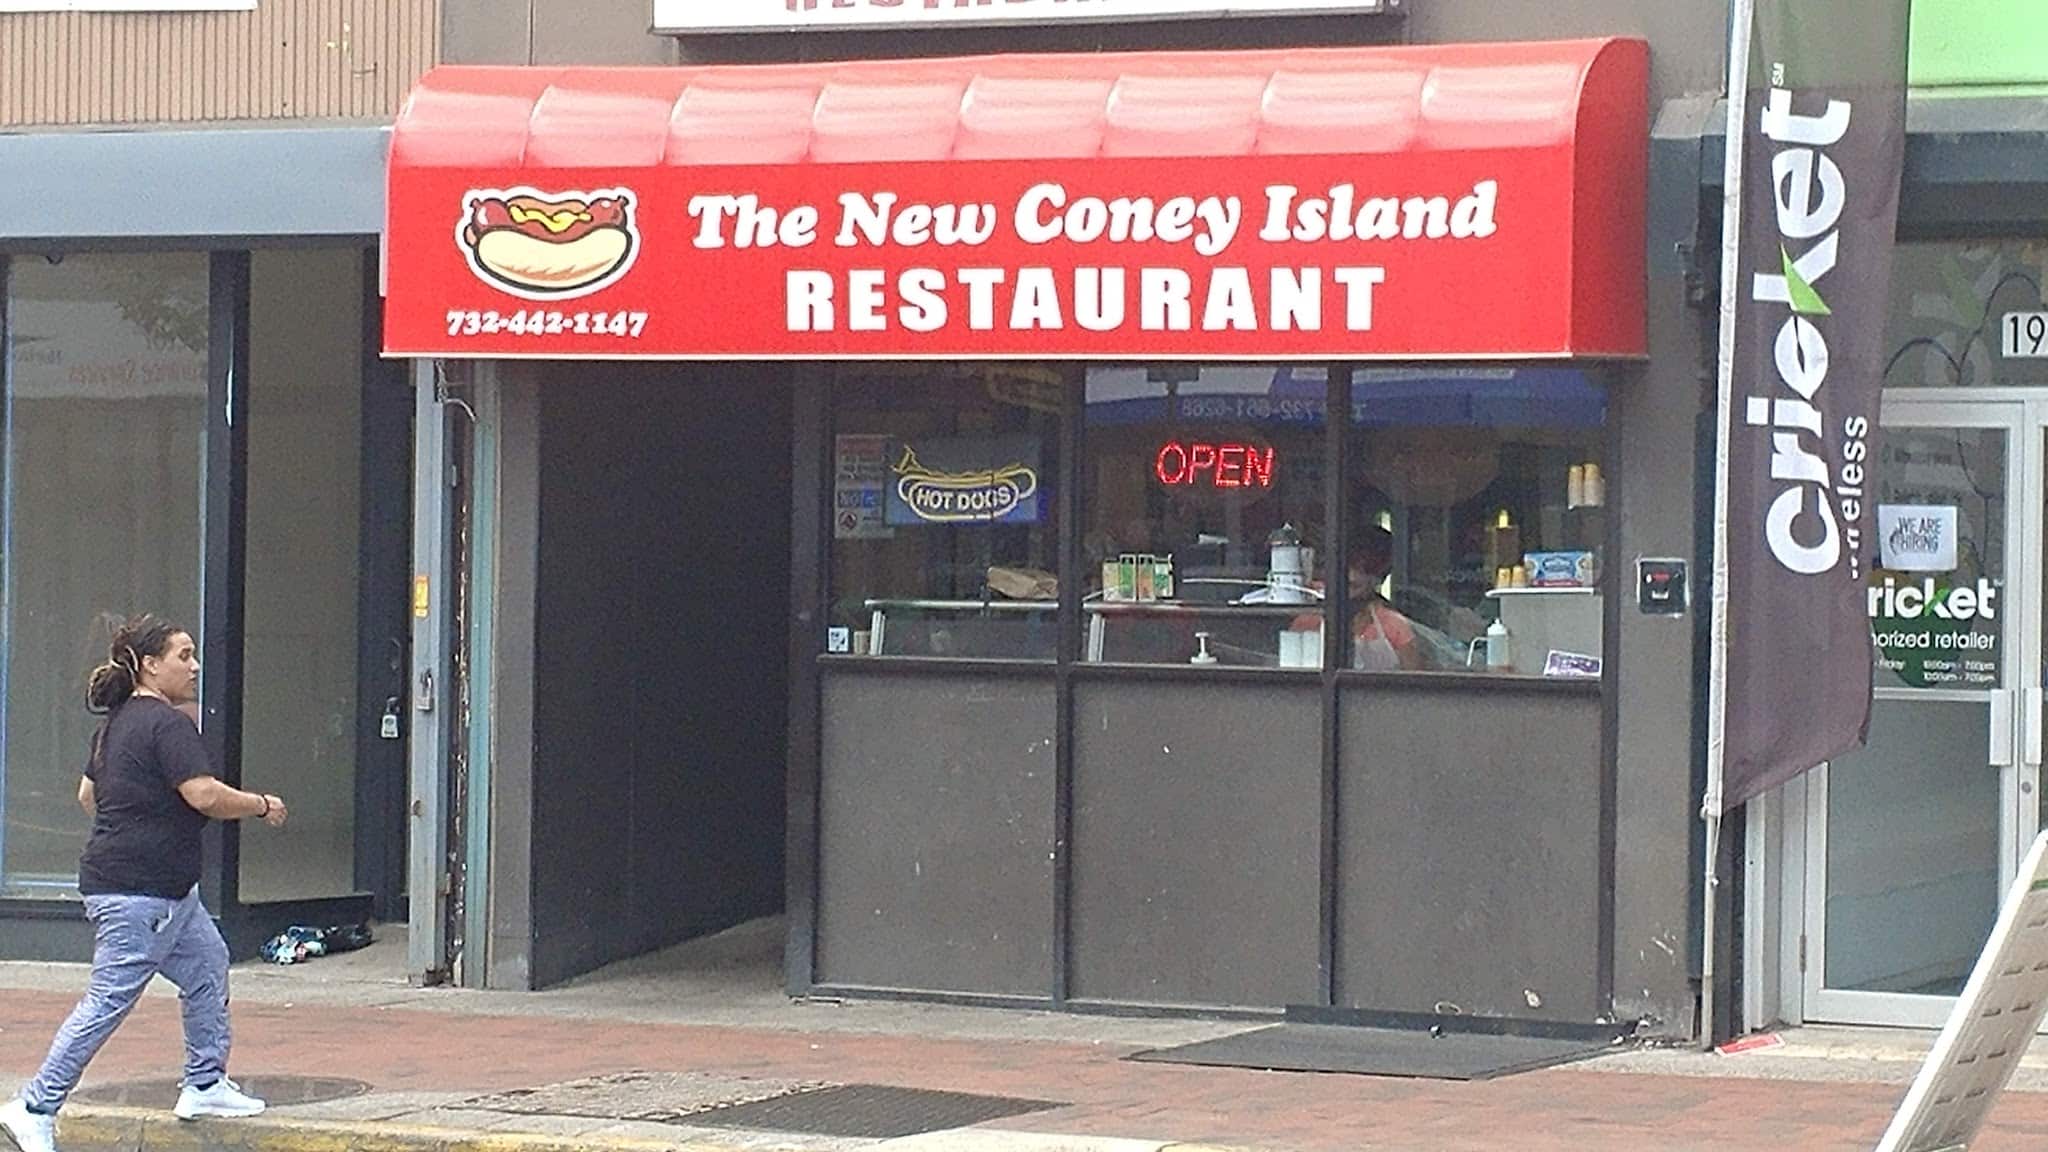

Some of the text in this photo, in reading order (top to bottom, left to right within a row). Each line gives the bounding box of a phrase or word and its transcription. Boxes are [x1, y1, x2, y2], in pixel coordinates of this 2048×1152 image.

[687, 179, 1499, 257] The New Coney Island
[786, 266, 1386, 332] RESTAURANT
[446, 309, 649, 338] 732-442-1147
[1747, 88, 1851, 574] cricket
[2010, 315, 2045, 354] 19
[1156, 440, 1275, 488] OPEN
[916, 486, 1012, 511] HOT DOGS
[1897, 516, 1943, 535] WE ARE
[1899, 532, 1940, 554] HIRING
[1867, 577, 1996, 620] ricket
[1871, 630, 1996, 649] orized retailer
